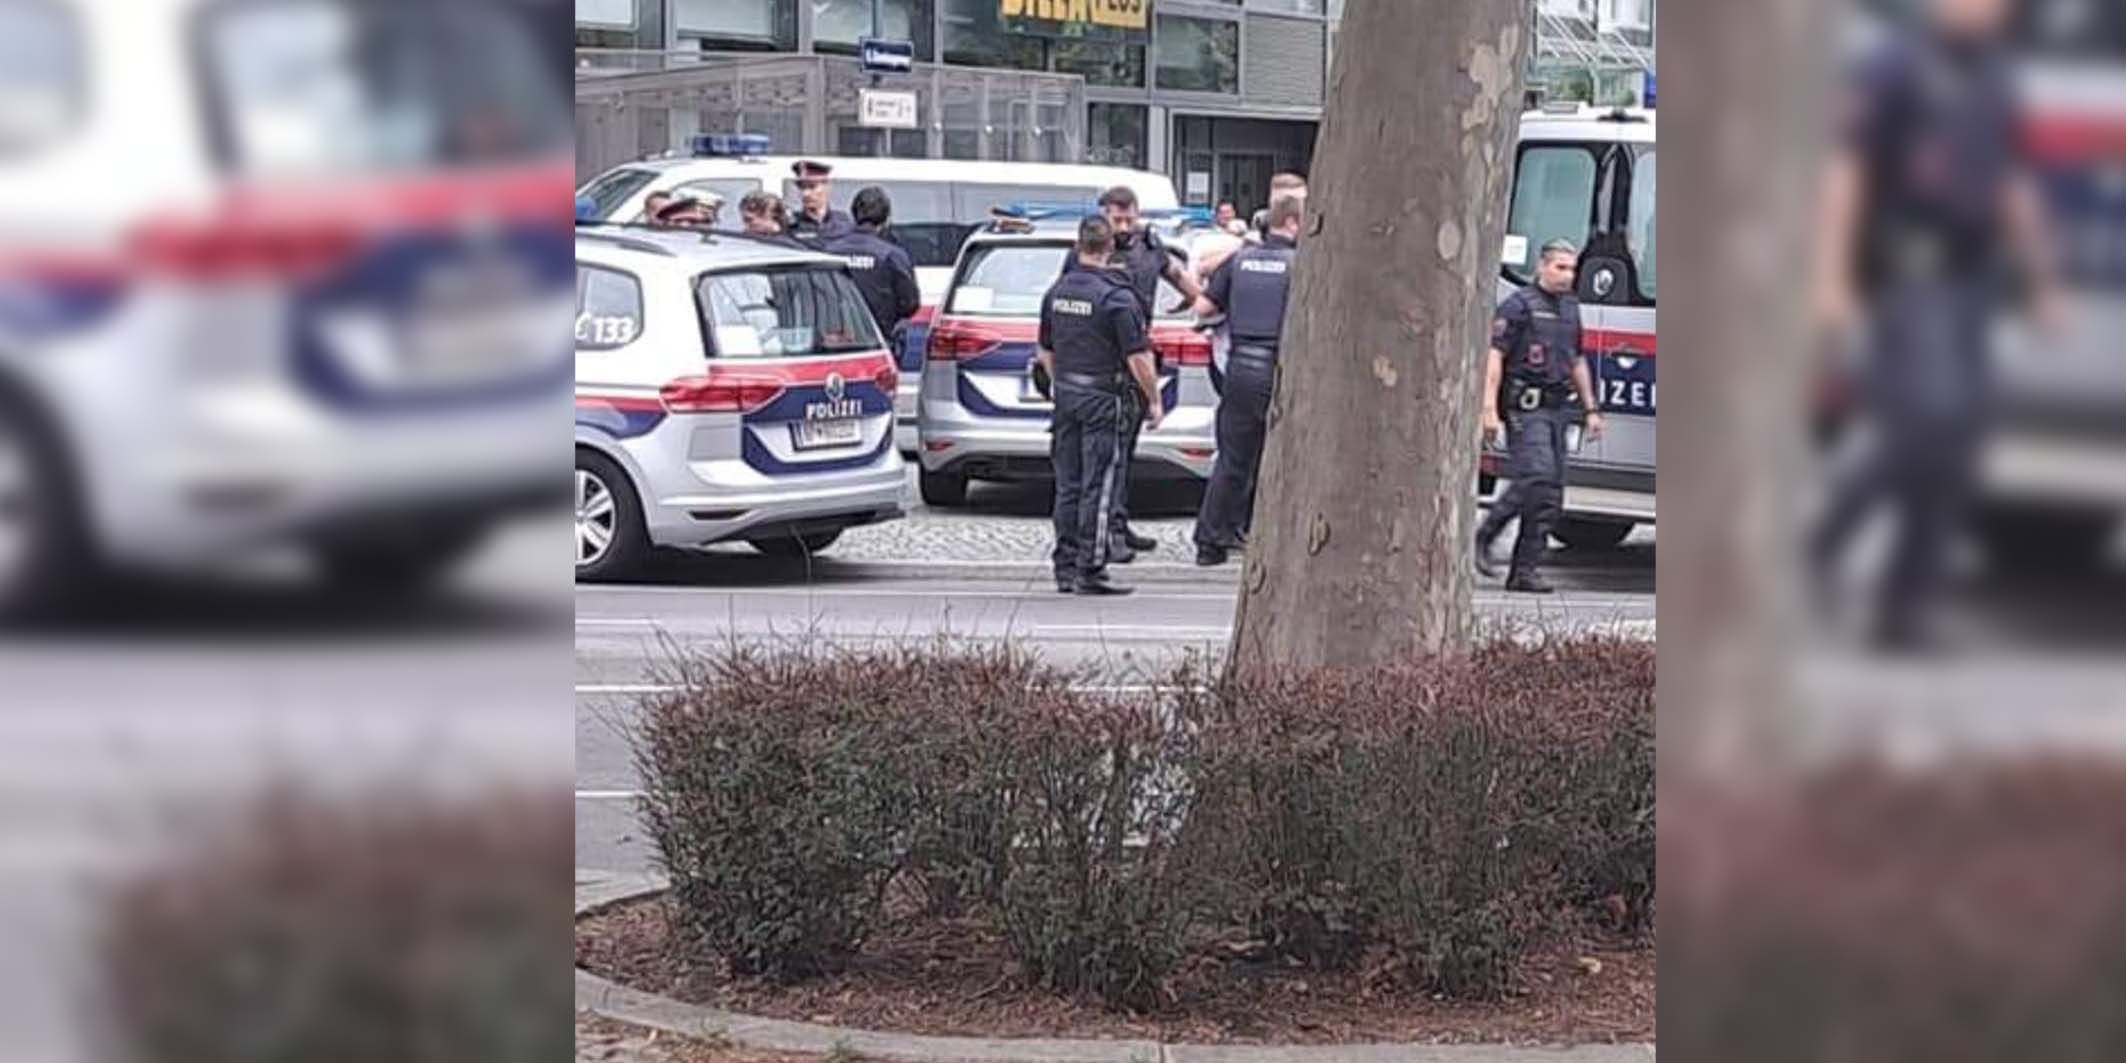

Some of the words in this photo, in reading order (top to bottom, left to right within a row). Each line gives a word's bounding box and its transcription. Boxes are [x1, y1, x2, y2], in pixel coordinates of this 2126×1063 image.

[593, 315, 635, 343] 133
[1599, 378, 1657, 408] IZEI
[806, 399, 863, 420] POLIZEI
